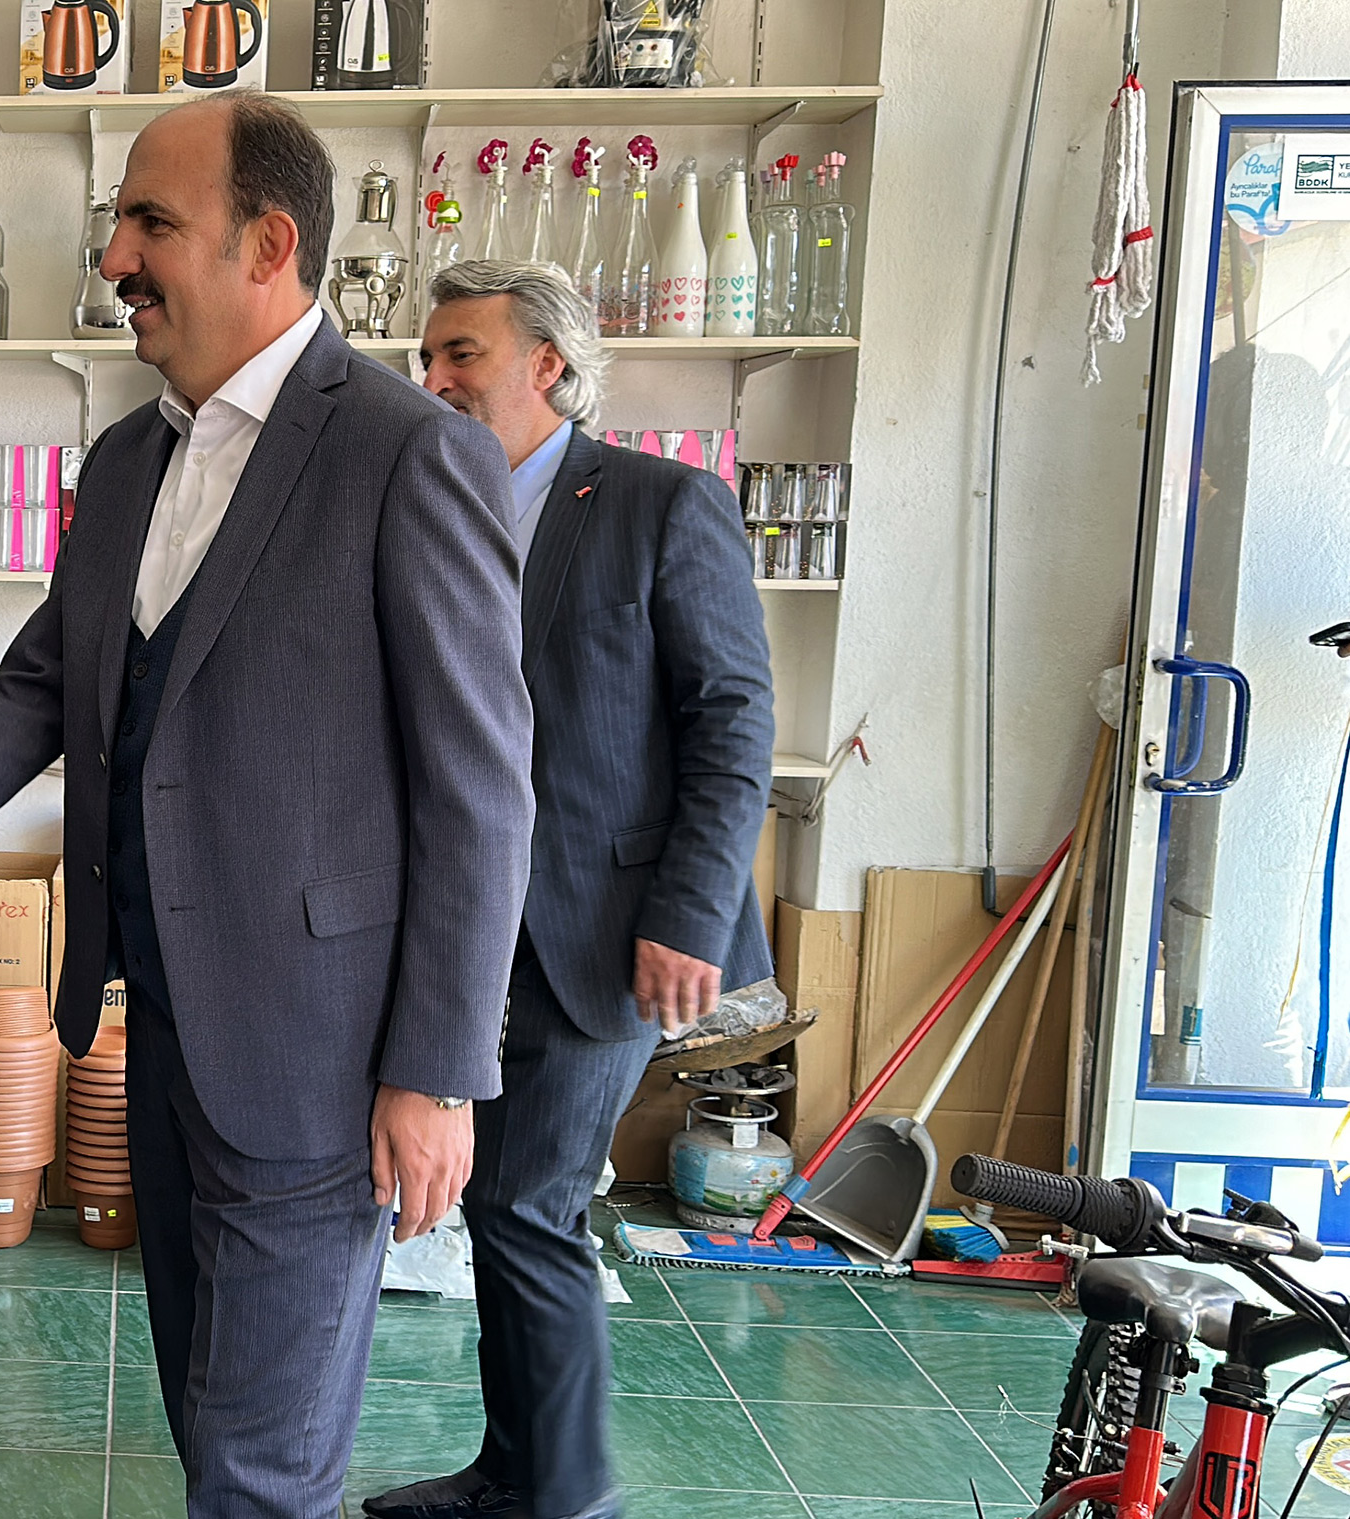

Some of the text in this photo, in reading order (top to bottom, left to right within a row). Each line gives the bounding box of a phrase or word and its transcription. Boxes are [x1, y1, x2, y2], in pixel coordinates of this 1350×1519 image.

[1243, 153, 1283, 176] Paraf
[1298, 179, 1329, 187] BDDK
[1230, 190, 1240, 198] bu
